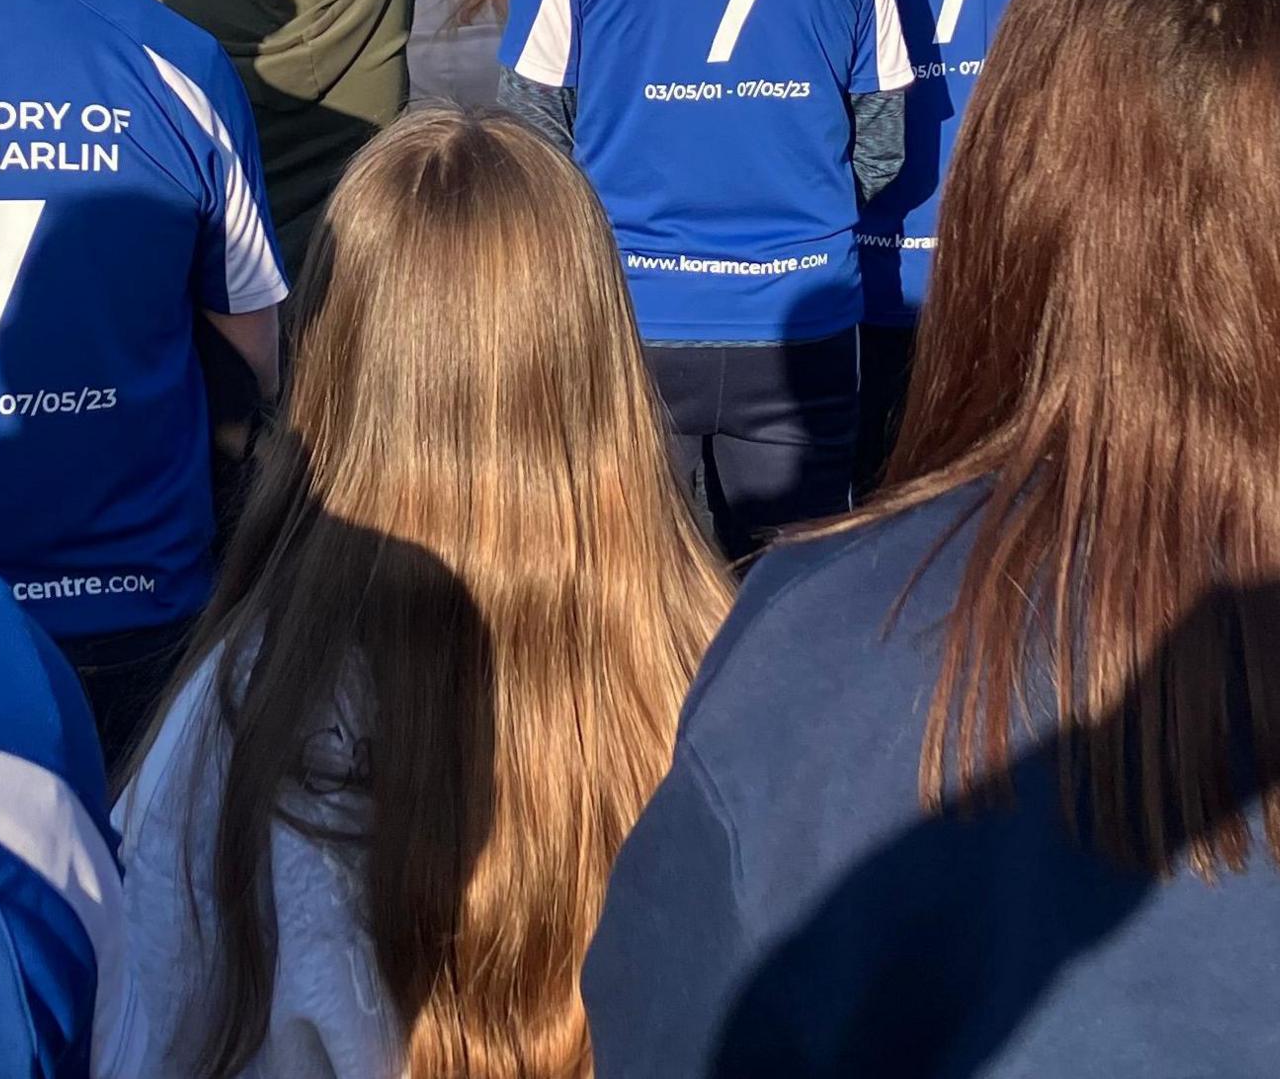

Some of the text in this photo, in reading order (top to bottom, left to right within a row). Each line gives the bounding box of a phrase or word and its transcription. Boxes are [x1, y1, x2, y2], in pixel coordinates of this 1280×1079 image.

[644, 82, 722, 103] 03/05/01
[737, 79, 811, 99] 07/05/23
[81, 104, 131, 134] OF
